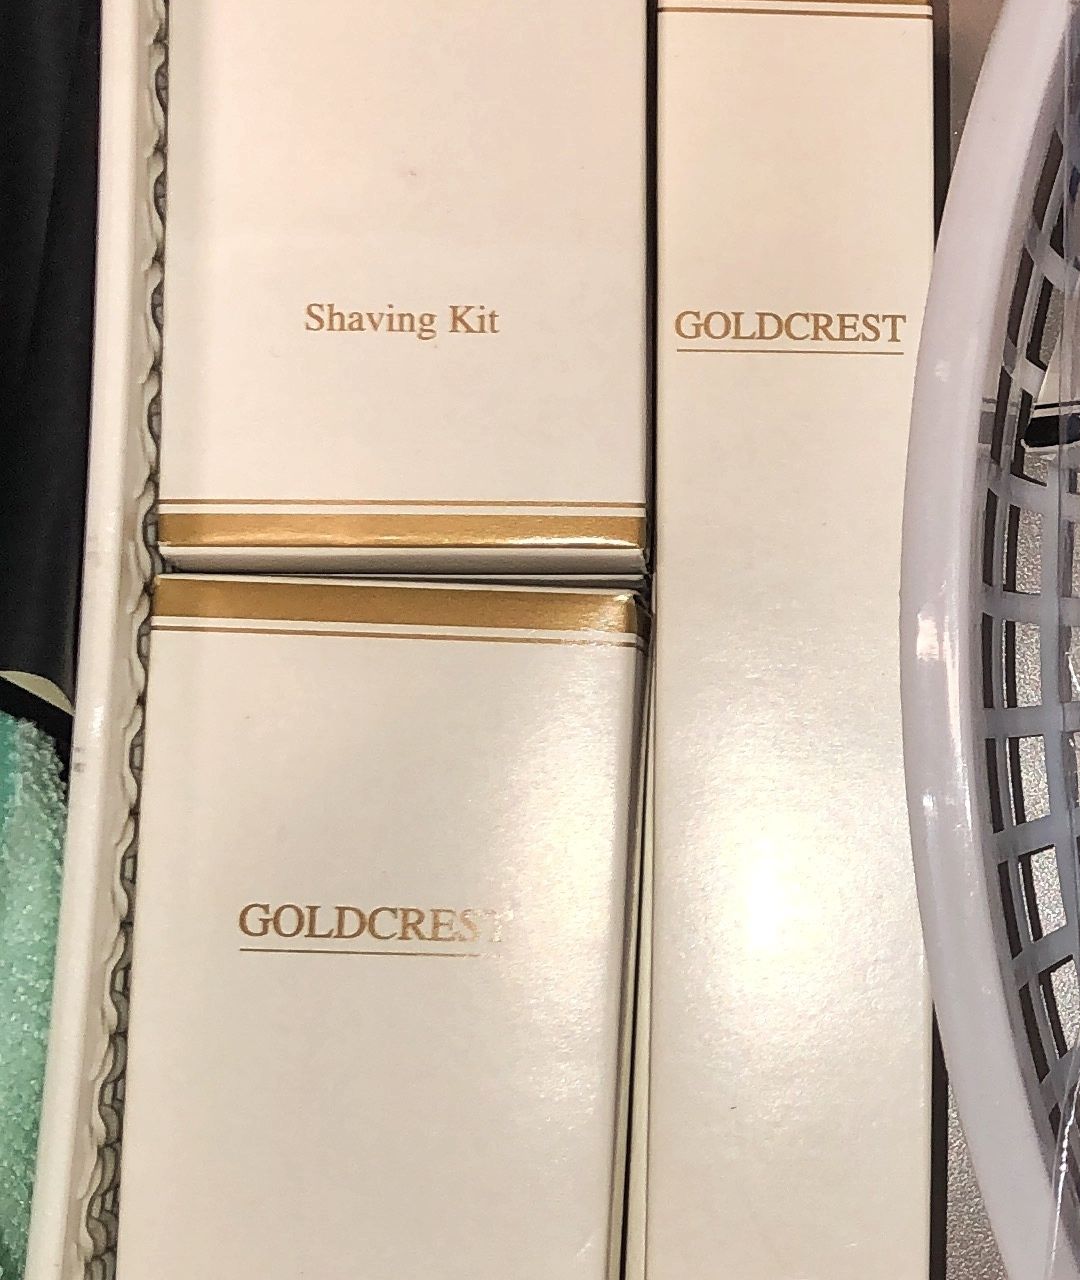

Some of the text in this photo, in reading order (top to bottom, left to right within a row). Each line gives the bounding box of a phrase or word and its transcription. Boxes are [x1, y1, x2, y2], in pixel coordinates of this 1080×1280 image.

[304, 302, 500, 341] Shaving Kit
[674, 310, 907, 343] GOLDCREST
